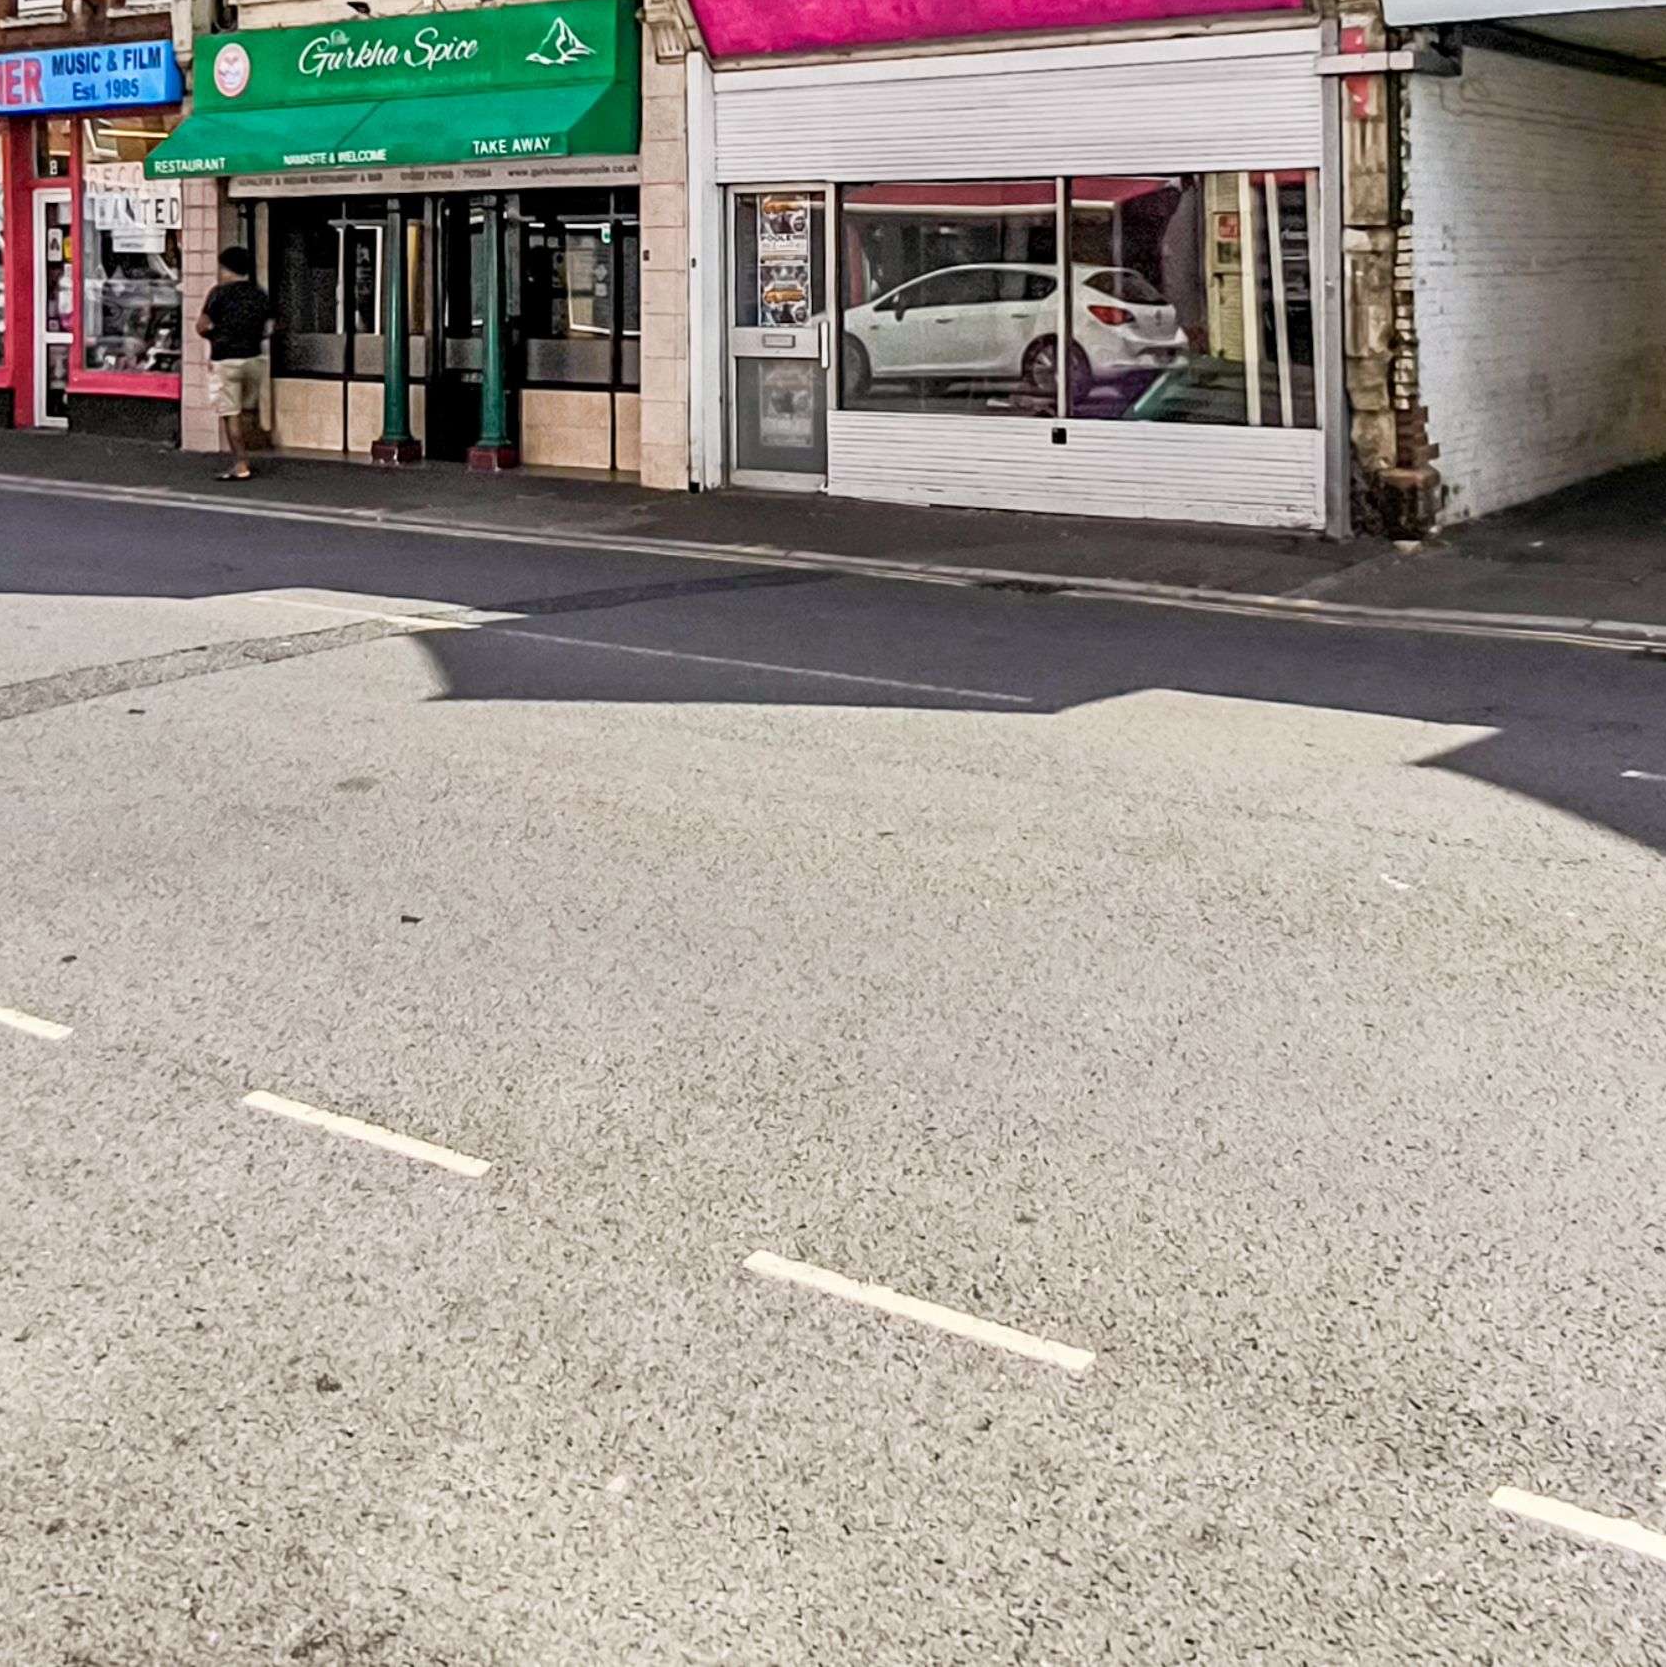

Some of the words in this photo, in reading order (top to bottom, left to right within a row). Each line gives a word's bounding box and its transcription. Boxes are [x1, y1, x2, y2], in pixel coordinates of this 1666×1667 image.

[51, 52, 101, 77] MUSIC
[106, 49, 118, 72] &
[123, 45, 162, 70] FILM
[298, 36, 400, 78] Gurkha
[404, 26, 479, 71] Spice
[104, 77, 140, 100] 1985
[154, 157, 226, 174] RESTAURANT
[283, 151, 327, 166] NAMASTE
[337, 148, 388, 163] WELCOME
[472, 139, 507, 155] TAKE
[512, 135, 551, 153] AWAY
